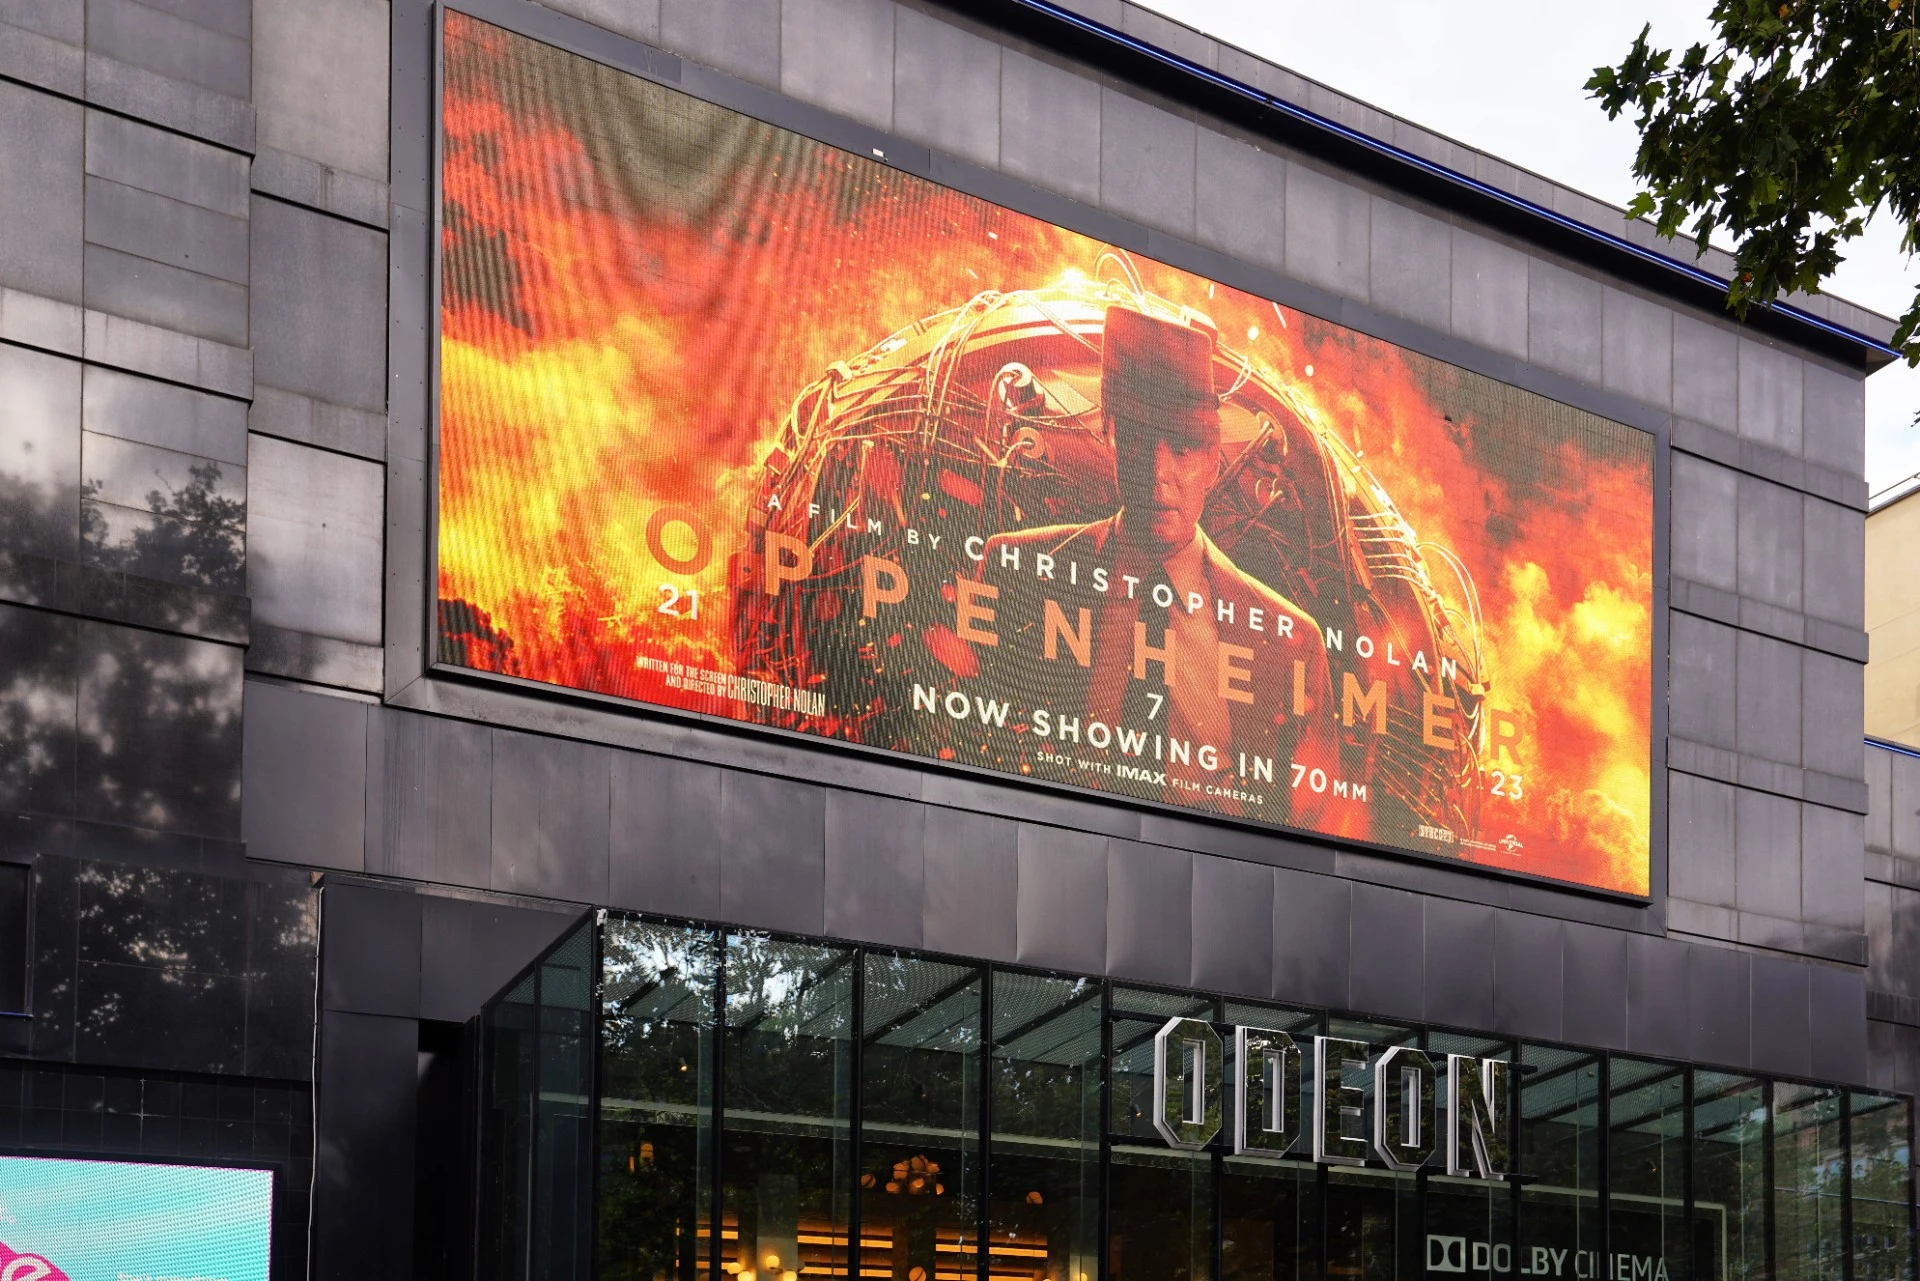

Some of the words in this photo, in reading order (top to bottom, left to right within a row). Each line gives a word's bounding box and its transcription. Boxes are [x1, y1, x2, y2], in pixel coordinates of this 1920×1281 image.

[646, 507, 1523, 766] OPPENHEIMER
[768, 494, 782, 510] A
[809, 503, 881, 535] FILM
[908, 529, 941, 549] BY
[965, 536, 1294, 639] CHRISTOPHER
[1326, 627, 1456, 680] NOLAN
[636, 656, 668, 673] WRITTEN
[670, 663, 684, 676] FOR
[686, 666, 698, 679] THE
[700, 669, 727, 685] SCREEN
[658, 584, 698, 620] 21
[1147, 692, 1163, 720] 7
[1491, 771, 1523, 800] 23
[665, 675, 682, 688] AND
[683, 678, 715, 695] DIRECTED
[717, 685, 727, 698] BY
[727, 675, 791, 710] CHRISTOPHER
[794, 685, 826, 717] NOLAN
[913, 683, 1009, 728] NOW
[1032, 710, 1218, 771] SHOWING
[1239, 752, 1273, 783] IN
[1291, 764, 1367, 802] 70MM
[1037, 751, 1071, 766] SHOT
[1078, 759, 1111, 774] WITH
[1117, 764, 1166, 786] IMAX
[1172, 780, 1201, 792] FILM
[1206, 785, 1263, 805] CAMERAS
[1153, 1016, 1508, 1180] ODEON
